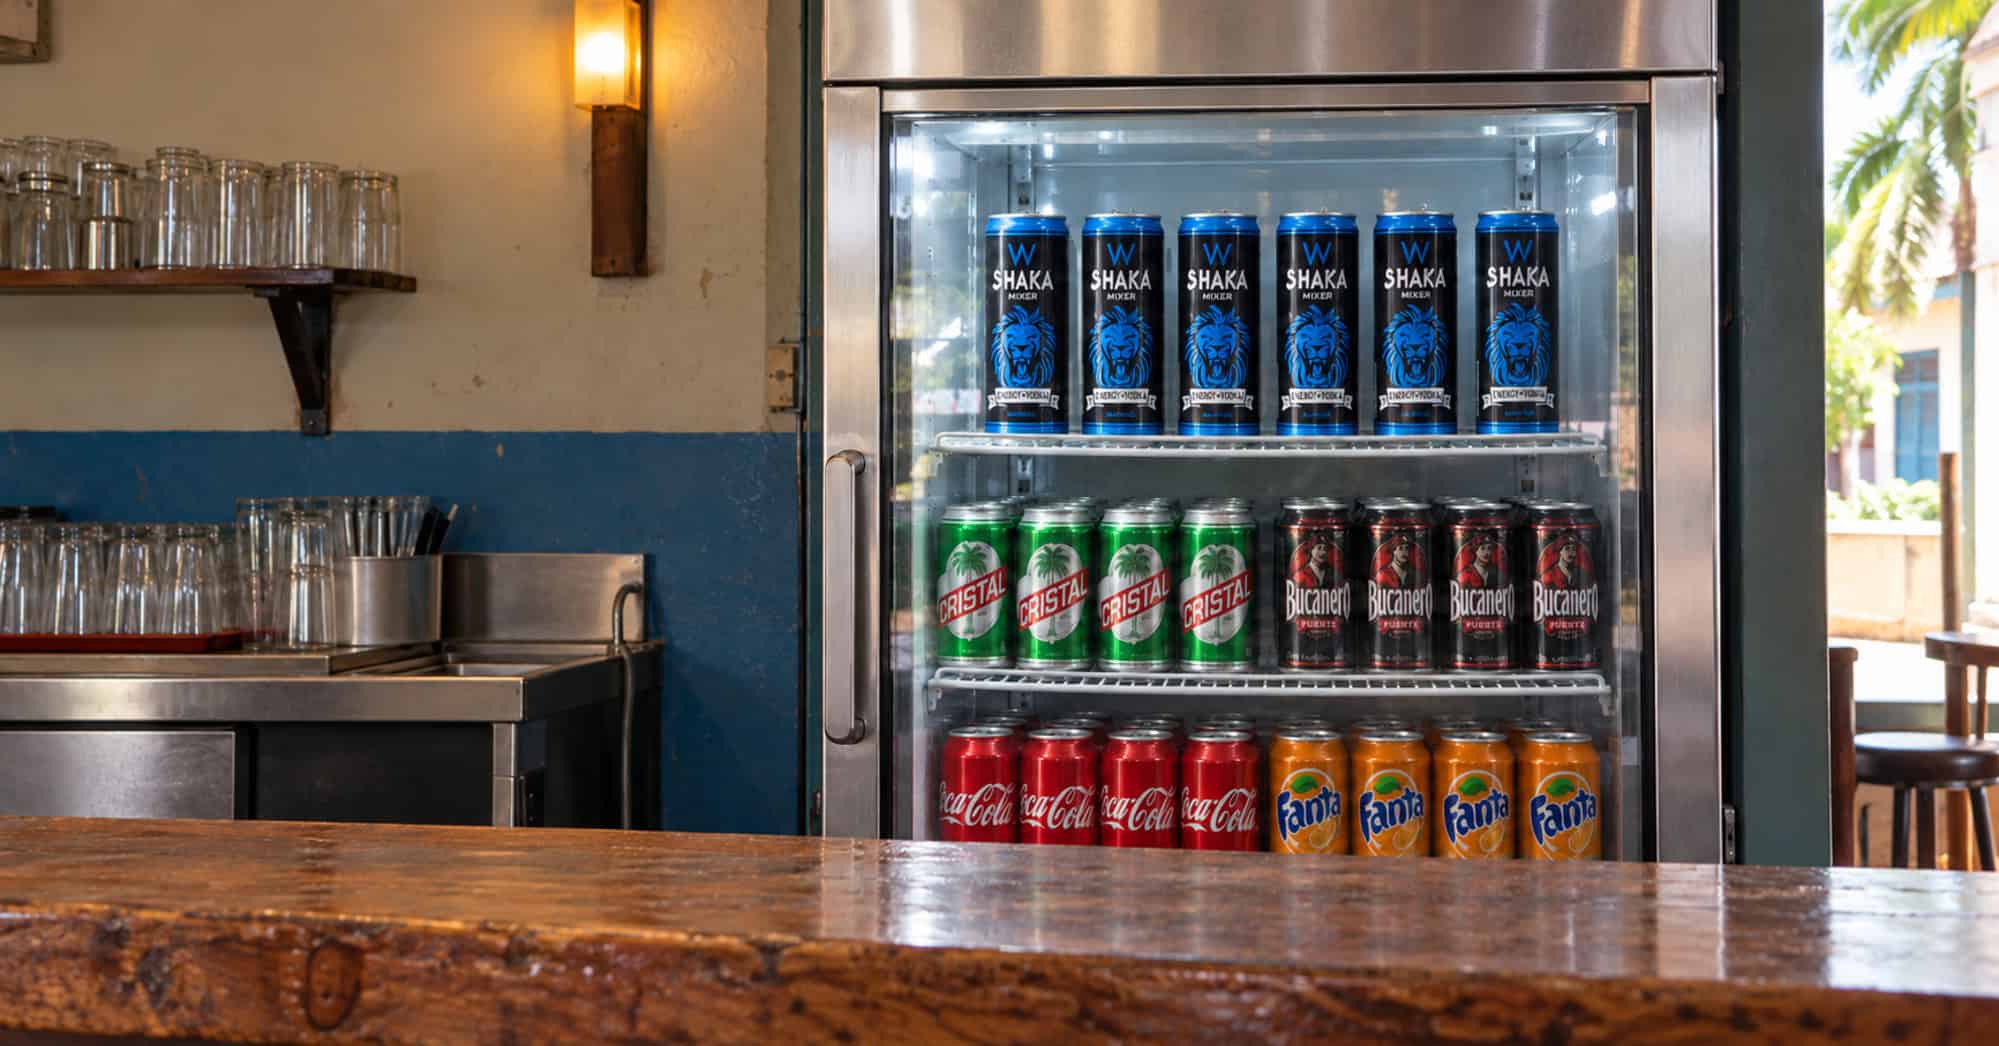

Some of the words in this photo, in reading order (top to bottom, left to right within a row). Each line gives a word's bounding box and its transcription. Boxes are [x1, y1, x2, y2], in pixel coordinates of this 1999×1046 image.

[992, 270, 1054, 291] SHAKA
[1090, 270, 1152, 291] SHAKA
[1187, 270, 1248, 291] SHAKA
[1286, 268, 1348, 290] SHAKA
[1302, 292, 1332, 300] MIXER
[1384, 268, 1447, 290] SHAKA
[1486, 266, 1550, 288] SHAKA
[940, 573, 1008, 621] CRISTAL
[1020, 578, 1088, 627] CRISTAL
[1102, 578, 1170, 628] CRISTAL
[1184, 574, 1252, 629] CRISTAL
[1286, 581, 1350, 622] Bucanero
[1368, 581, 1432, 621] Bucanero
[1450, 581, 1514, 621] Bucanero
[1533, 581, 1598, 622] Bucanero
[1277, 787, 1342, 840] Fanta
[1360, 788, 1424, 842] Fanta
[1444, 790, 1509, 843] Fanta
[1531, 791, 1596, 846] Fanta
